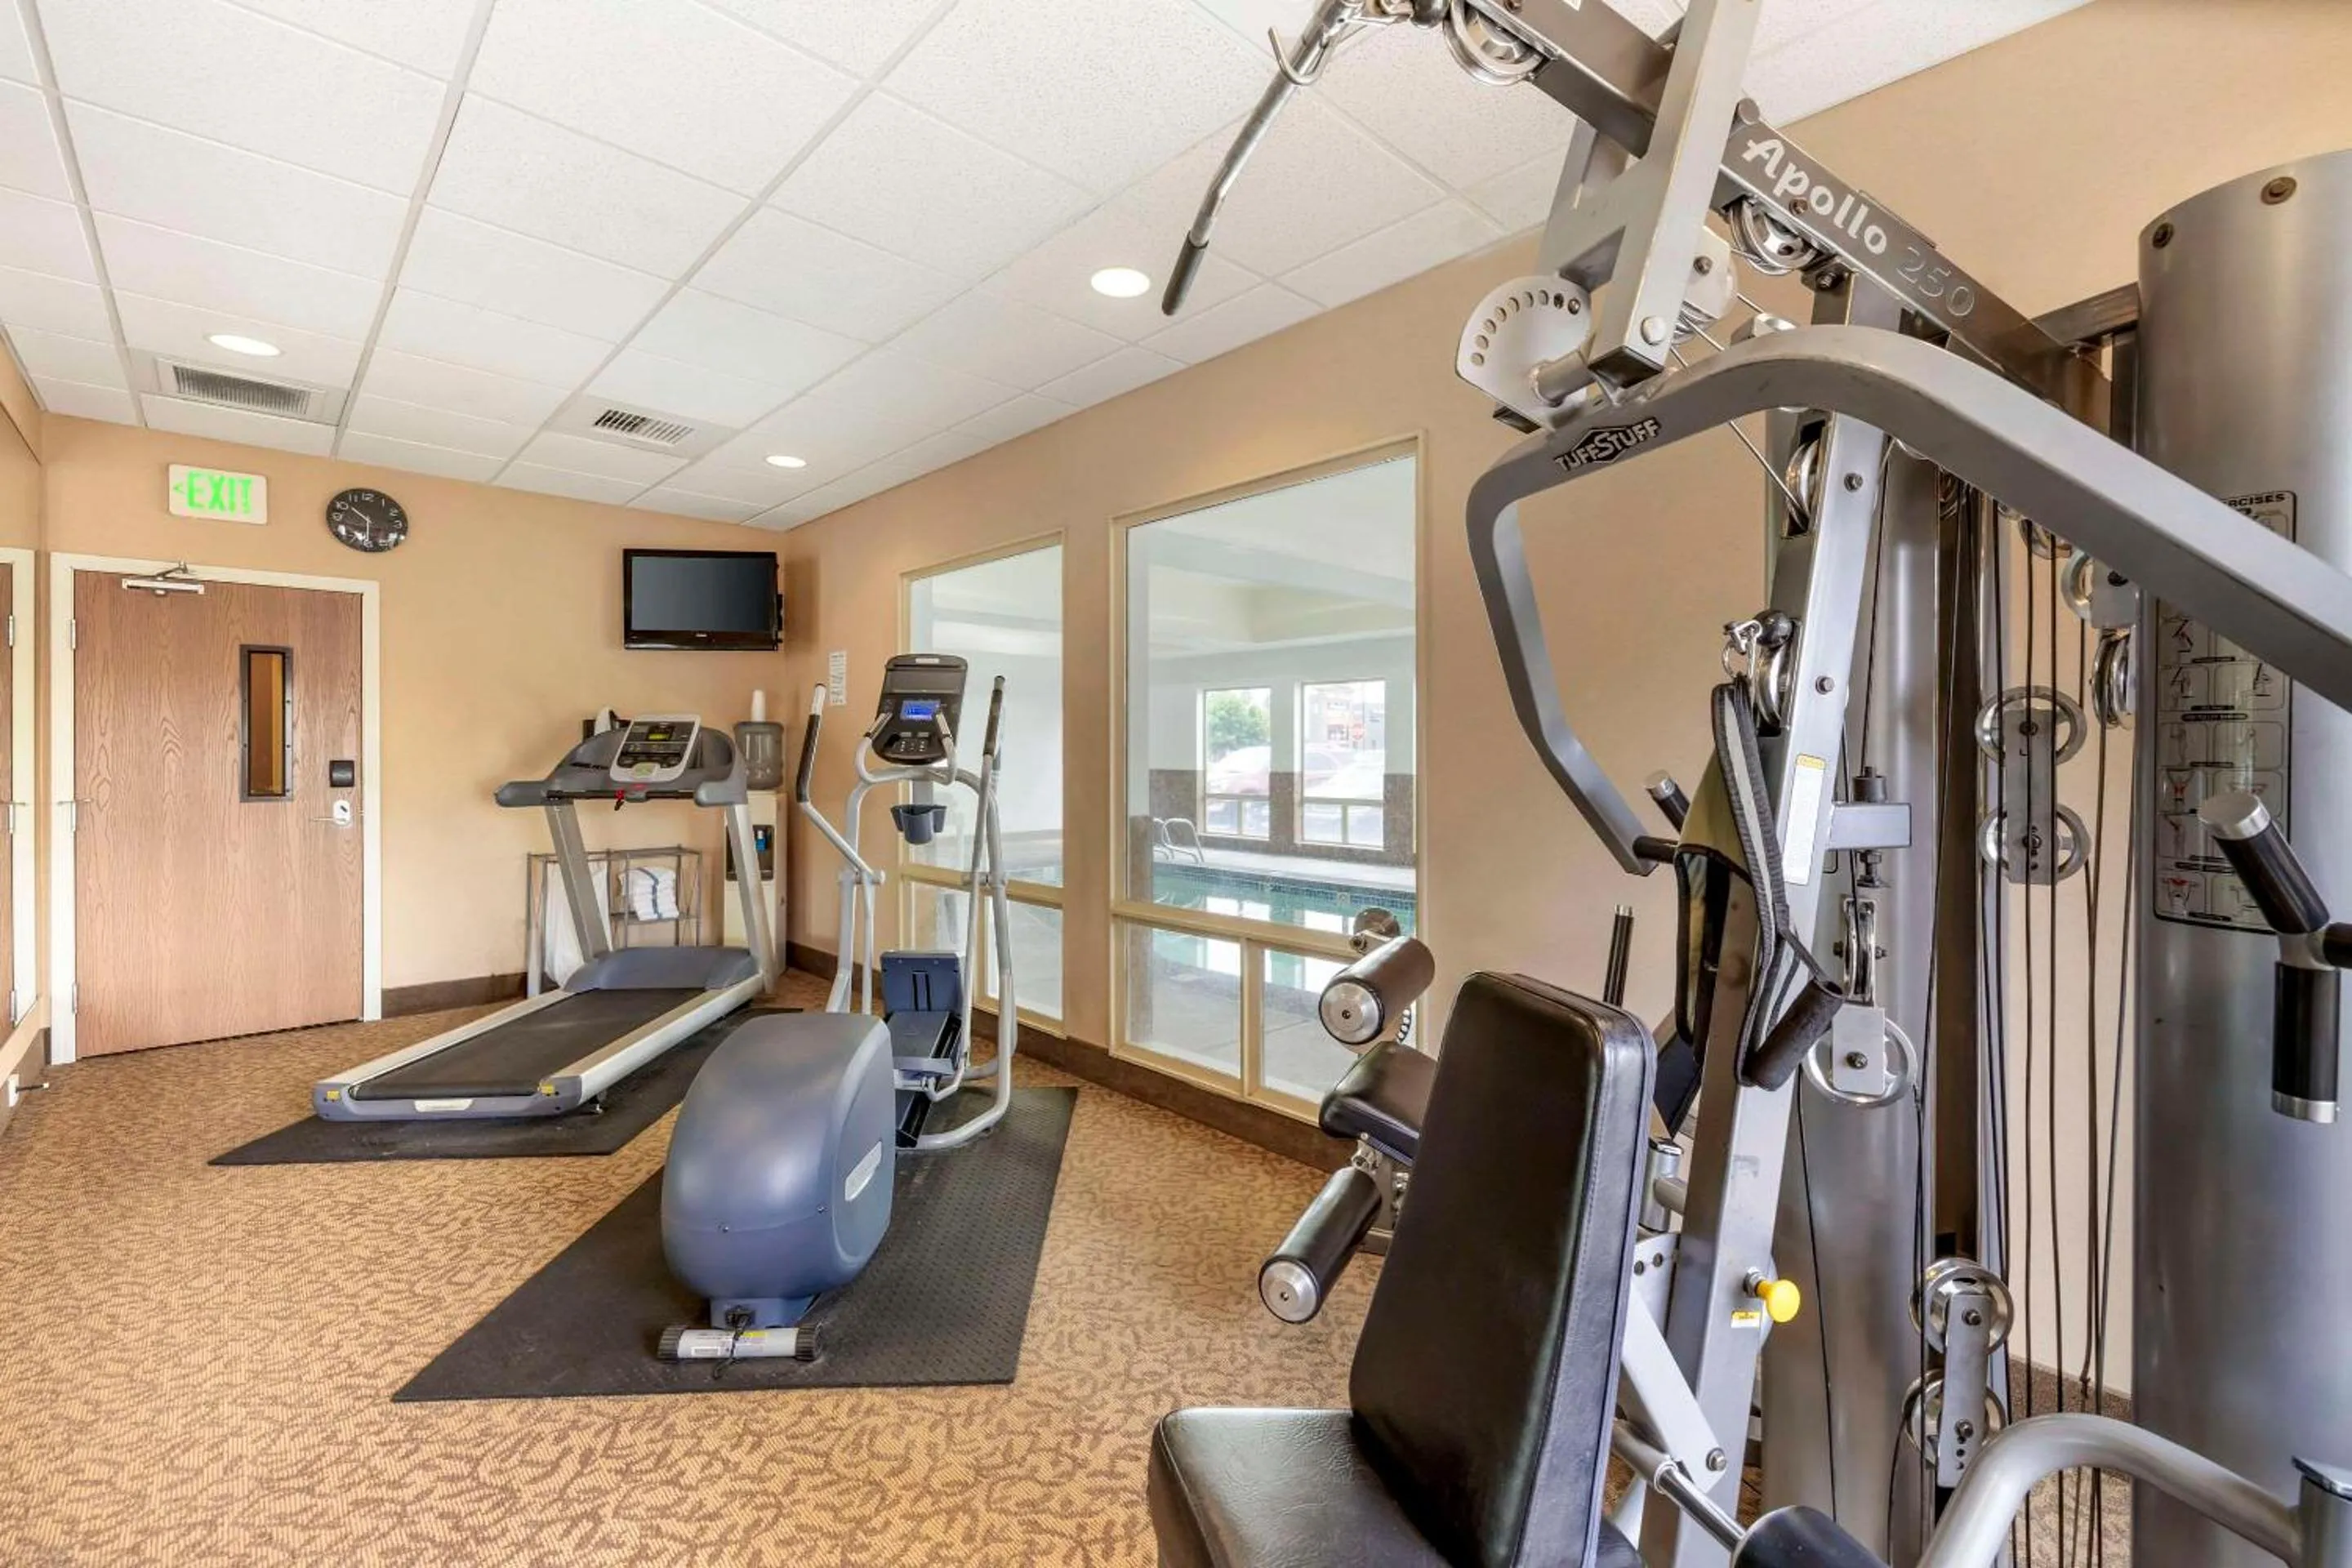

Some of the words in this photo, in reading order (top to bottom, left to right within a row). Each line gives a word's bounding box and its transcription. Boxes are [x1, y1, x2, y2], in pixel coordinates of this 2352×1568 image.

[1741, 138, 1888, 256] Apollo
[1895, 246, 1976, 317] 250
[187, 470, 252, 514] EXIT
[348, 493, 359, 503] 11
[361, 492, 375, 503] 12
[335, 500, 350, 510] 10
[332, 512, 343, 522] 9
[391, 519, 403, 529] 3
